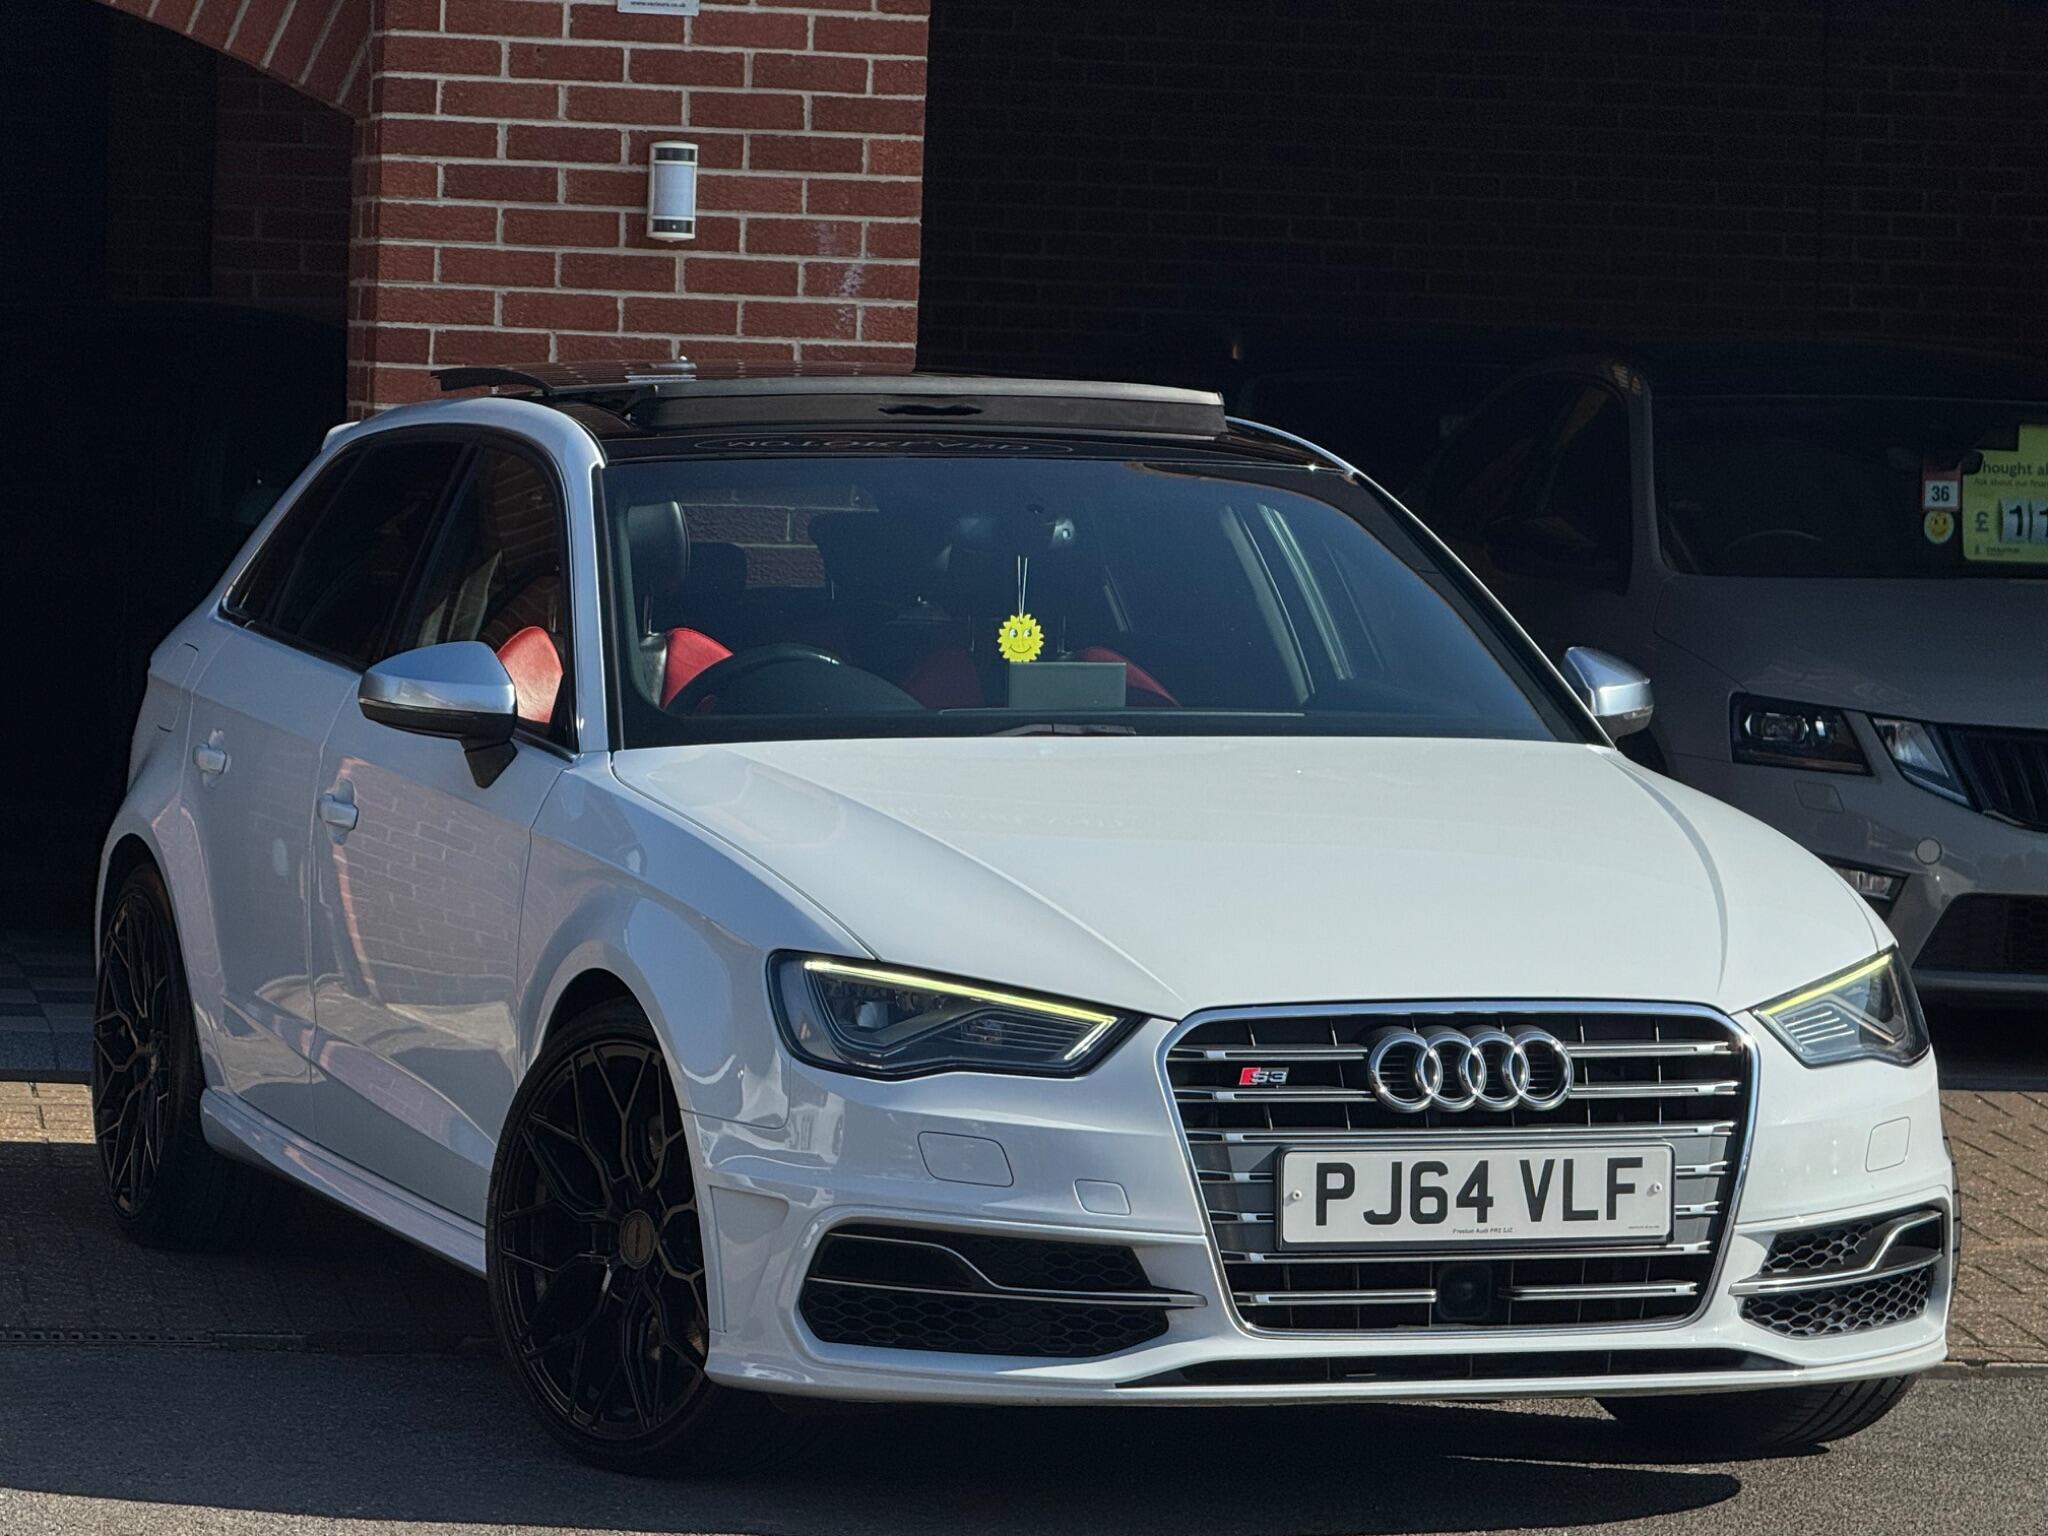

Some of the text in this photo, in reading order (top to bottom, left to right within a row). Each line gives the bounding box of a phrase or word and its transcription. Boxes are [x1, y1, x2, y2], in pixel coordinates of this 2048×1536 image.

[1983, 462, 2032, 478] hought
[1931, 485, 1950, 502] 36
[1975, 511, 1989, 532] £
[1249, 1070, 1288, 1084] S3
[1315, 1157, 1643, 1226] PJ64 VLF
